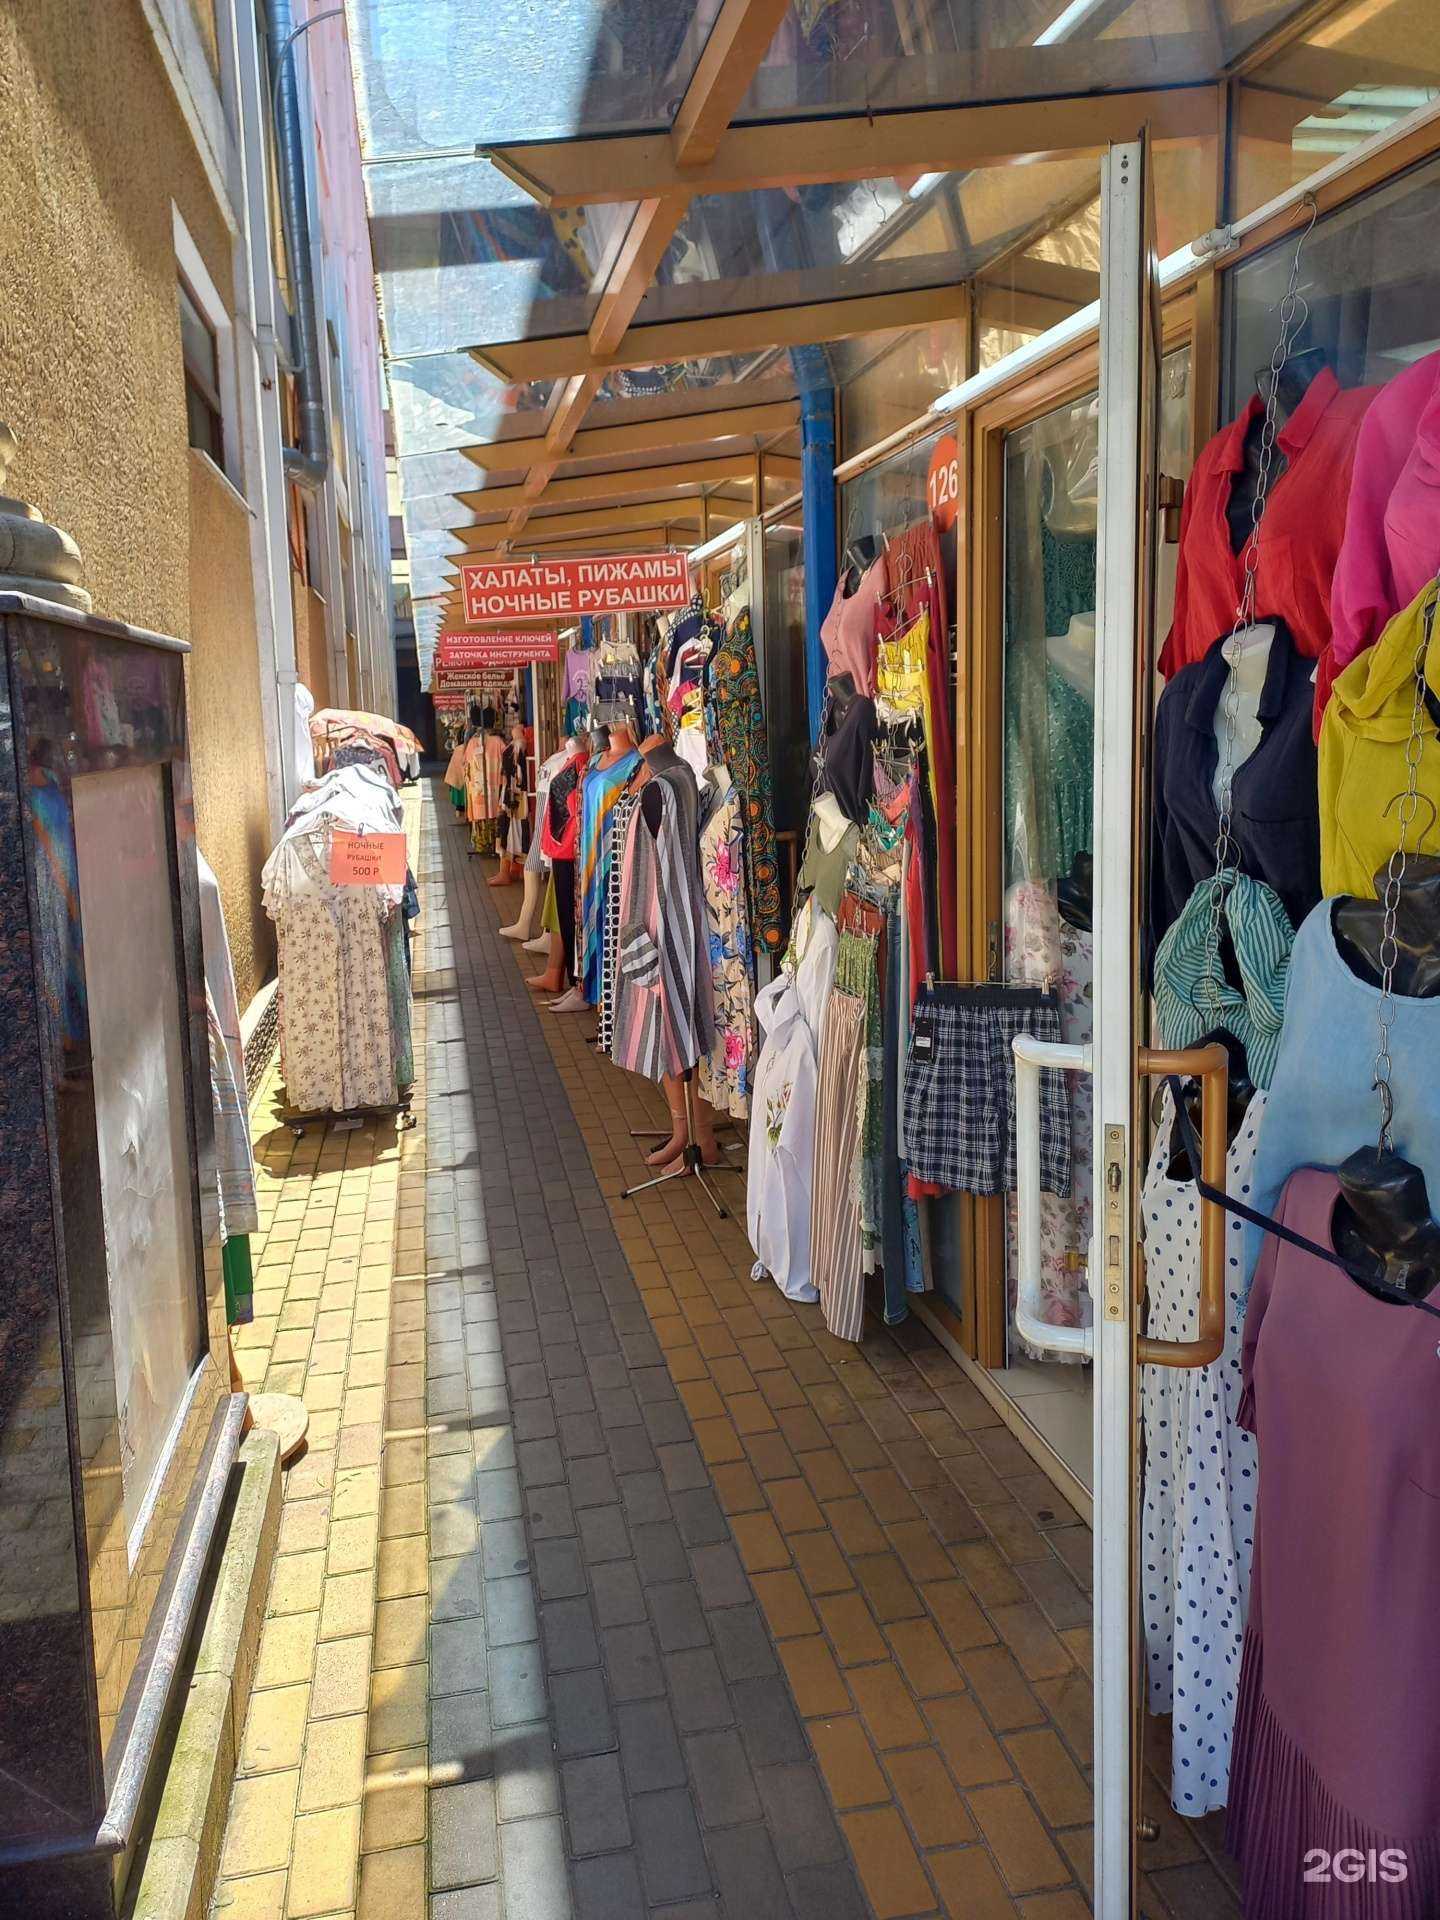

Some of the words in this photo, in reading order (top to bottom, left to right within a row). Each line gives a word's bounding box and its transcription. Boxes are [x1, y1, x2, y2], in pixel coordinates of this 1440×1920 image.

[929, 459, 958, 508] 126
[469, 566, 572, 590] ХАЛАТЫ,
[578, 559, 682, 583] ПИЖАМЫ
[471, 591, 572, 615] НОЧНЫЕ
[578, 583, 684, 608] РУБАШКИ
[446, 635, 513, 644] ИЗГОТОВЛЕНИЕ
[515, 633, 552, 643] КЛЮЧЕЙ
[449, 651, 488, 659] ЗАТОЧКА
[489, 650, 551, 658] ИНСТРУМЕНТА
[347, 841, 385, 850] НОЧНЫЕ
[347, 854, 382, 862] РУБАШКИ
[352, 866, 371, 876] 500
